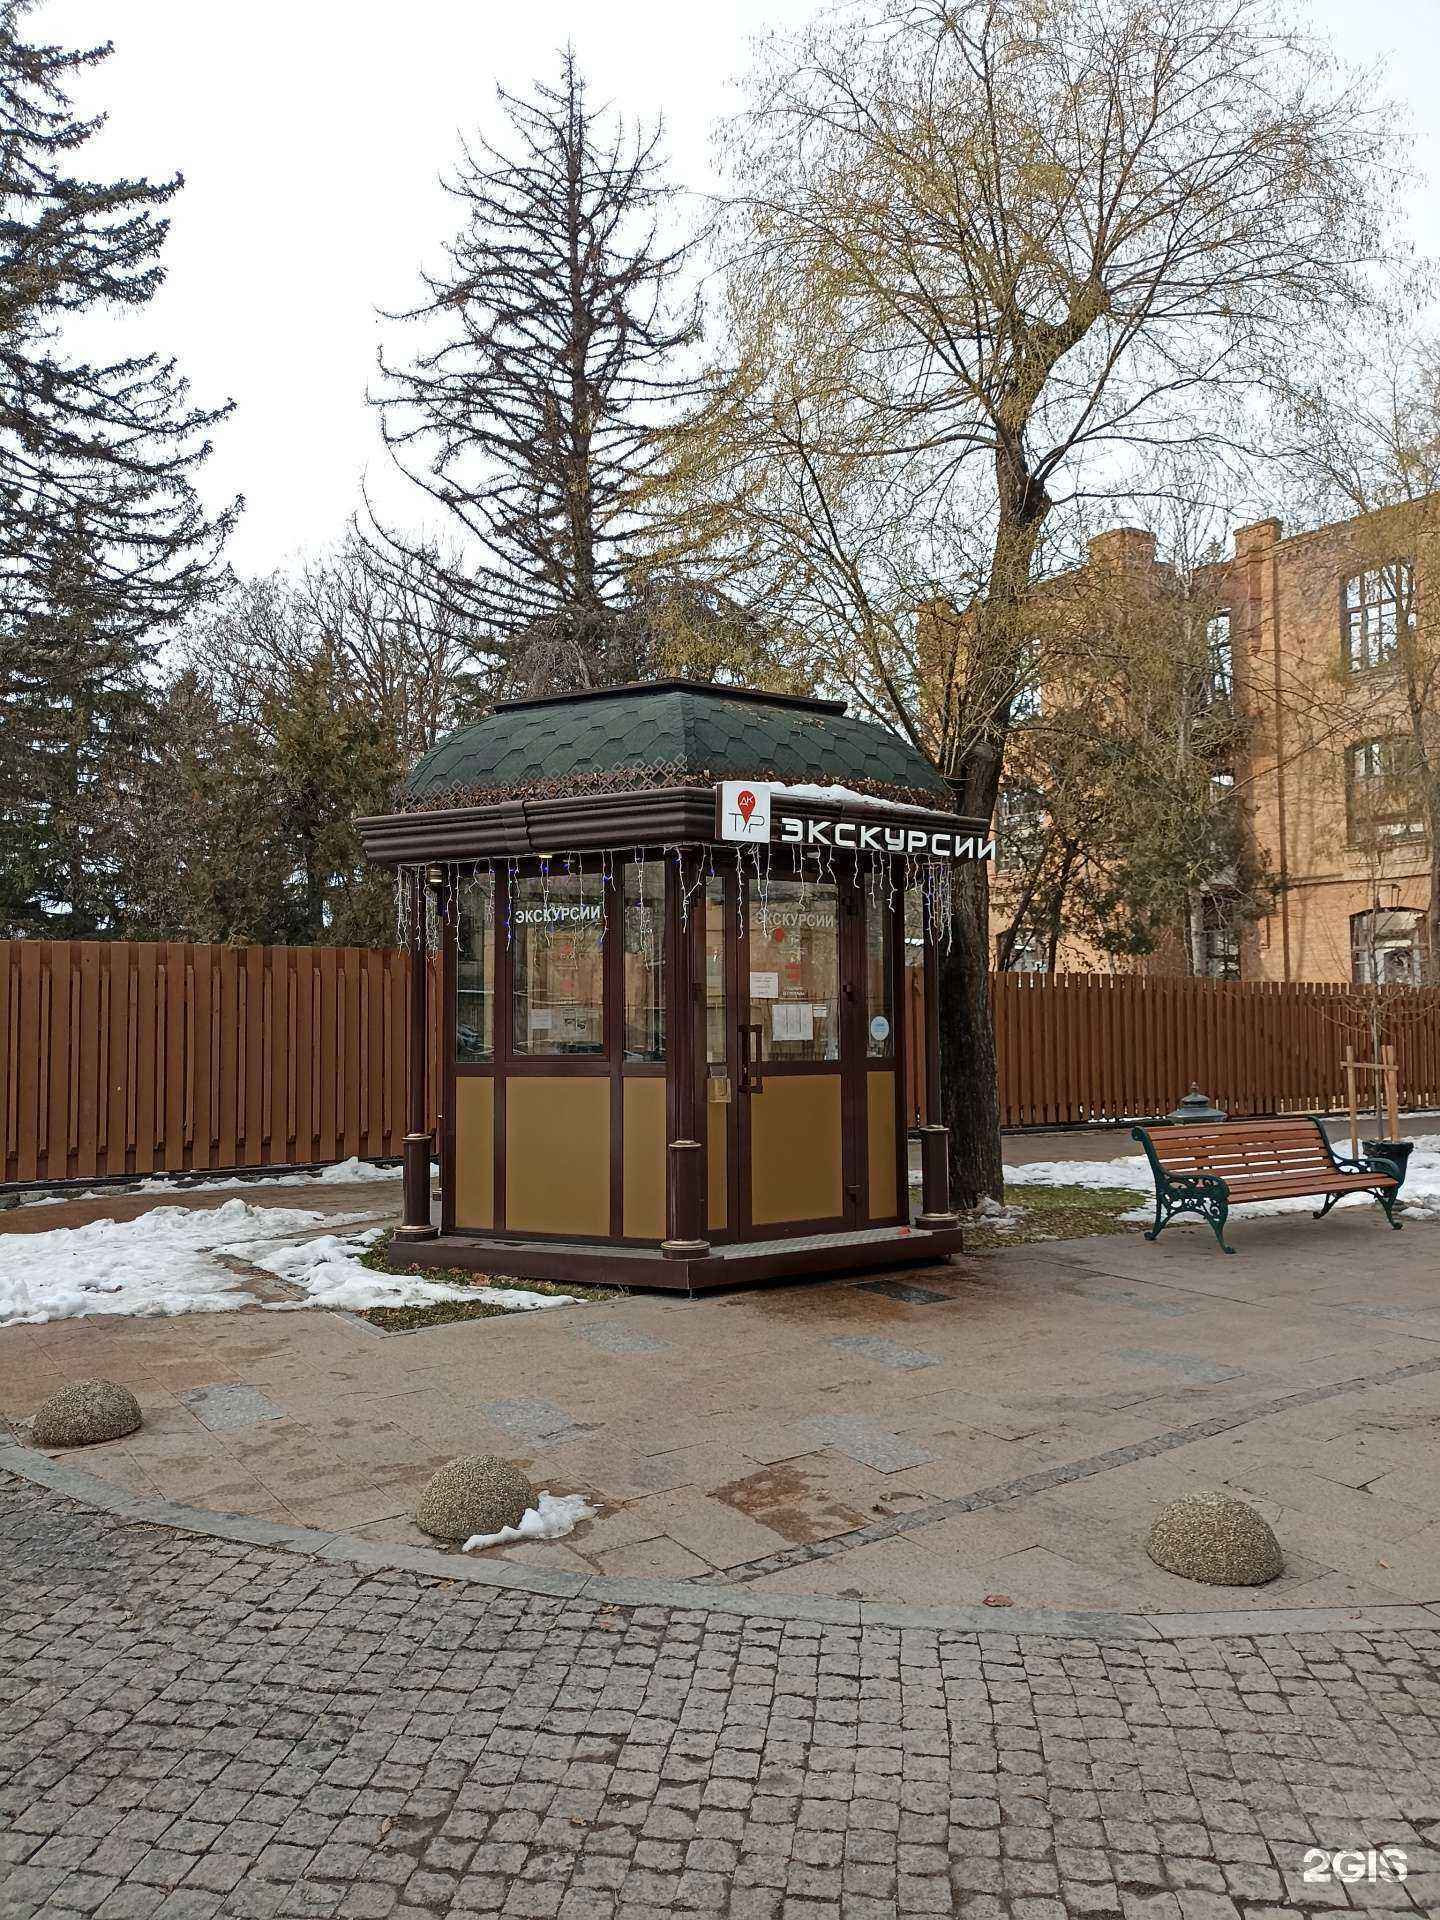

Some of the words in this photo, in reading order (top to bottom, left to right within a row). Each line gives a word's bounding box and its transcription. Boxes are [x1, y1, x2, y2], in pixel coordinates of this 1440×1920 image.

[781, 817, 997, 859] ЭКСКУРСИИ
[514, 905, 601, 924] ЭКСКУРСИИ
[756, 912, 835, 928] ЭКСКУРСИИ
